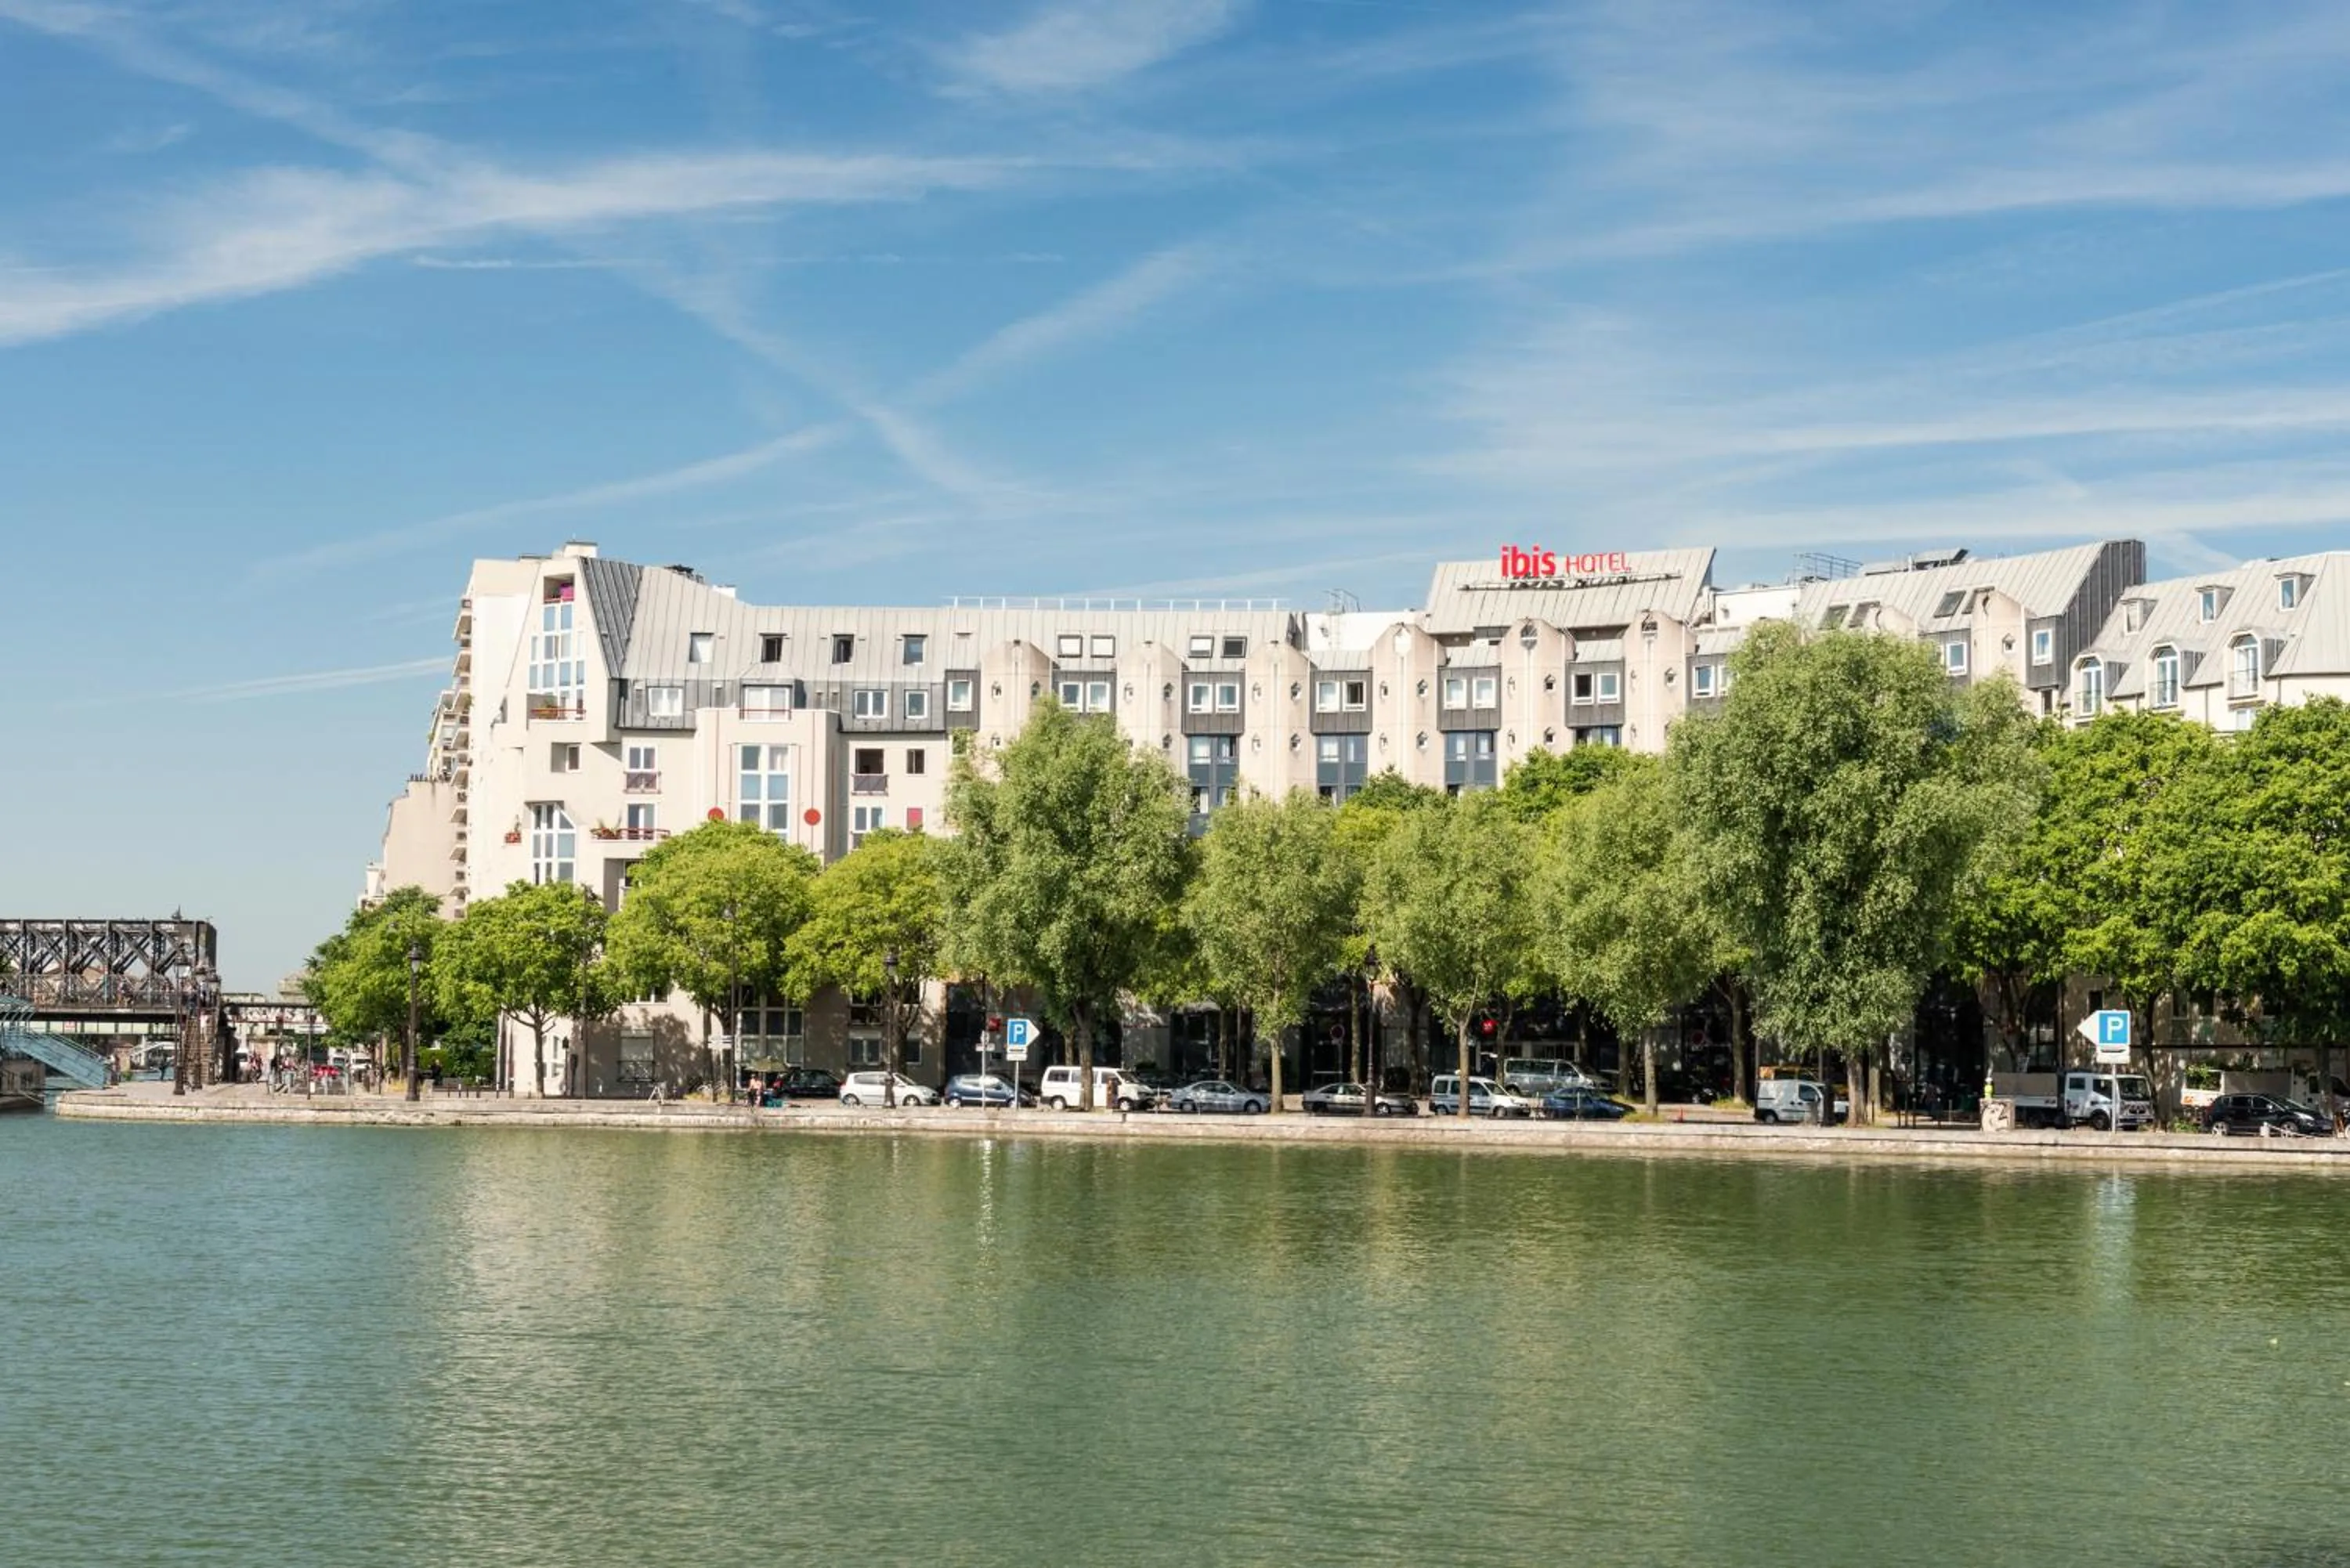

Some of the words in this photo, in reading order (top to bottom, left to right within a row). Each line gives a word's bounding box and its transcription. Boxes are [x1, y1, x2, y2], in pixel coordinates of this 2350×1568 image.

[1502, 546, 1556, 577] ibis
[1567, 552, 1629, 573] HOTEL
[1013, 1024, 1025, 1042] P
[2106, 1016, 2124, 1041] P
